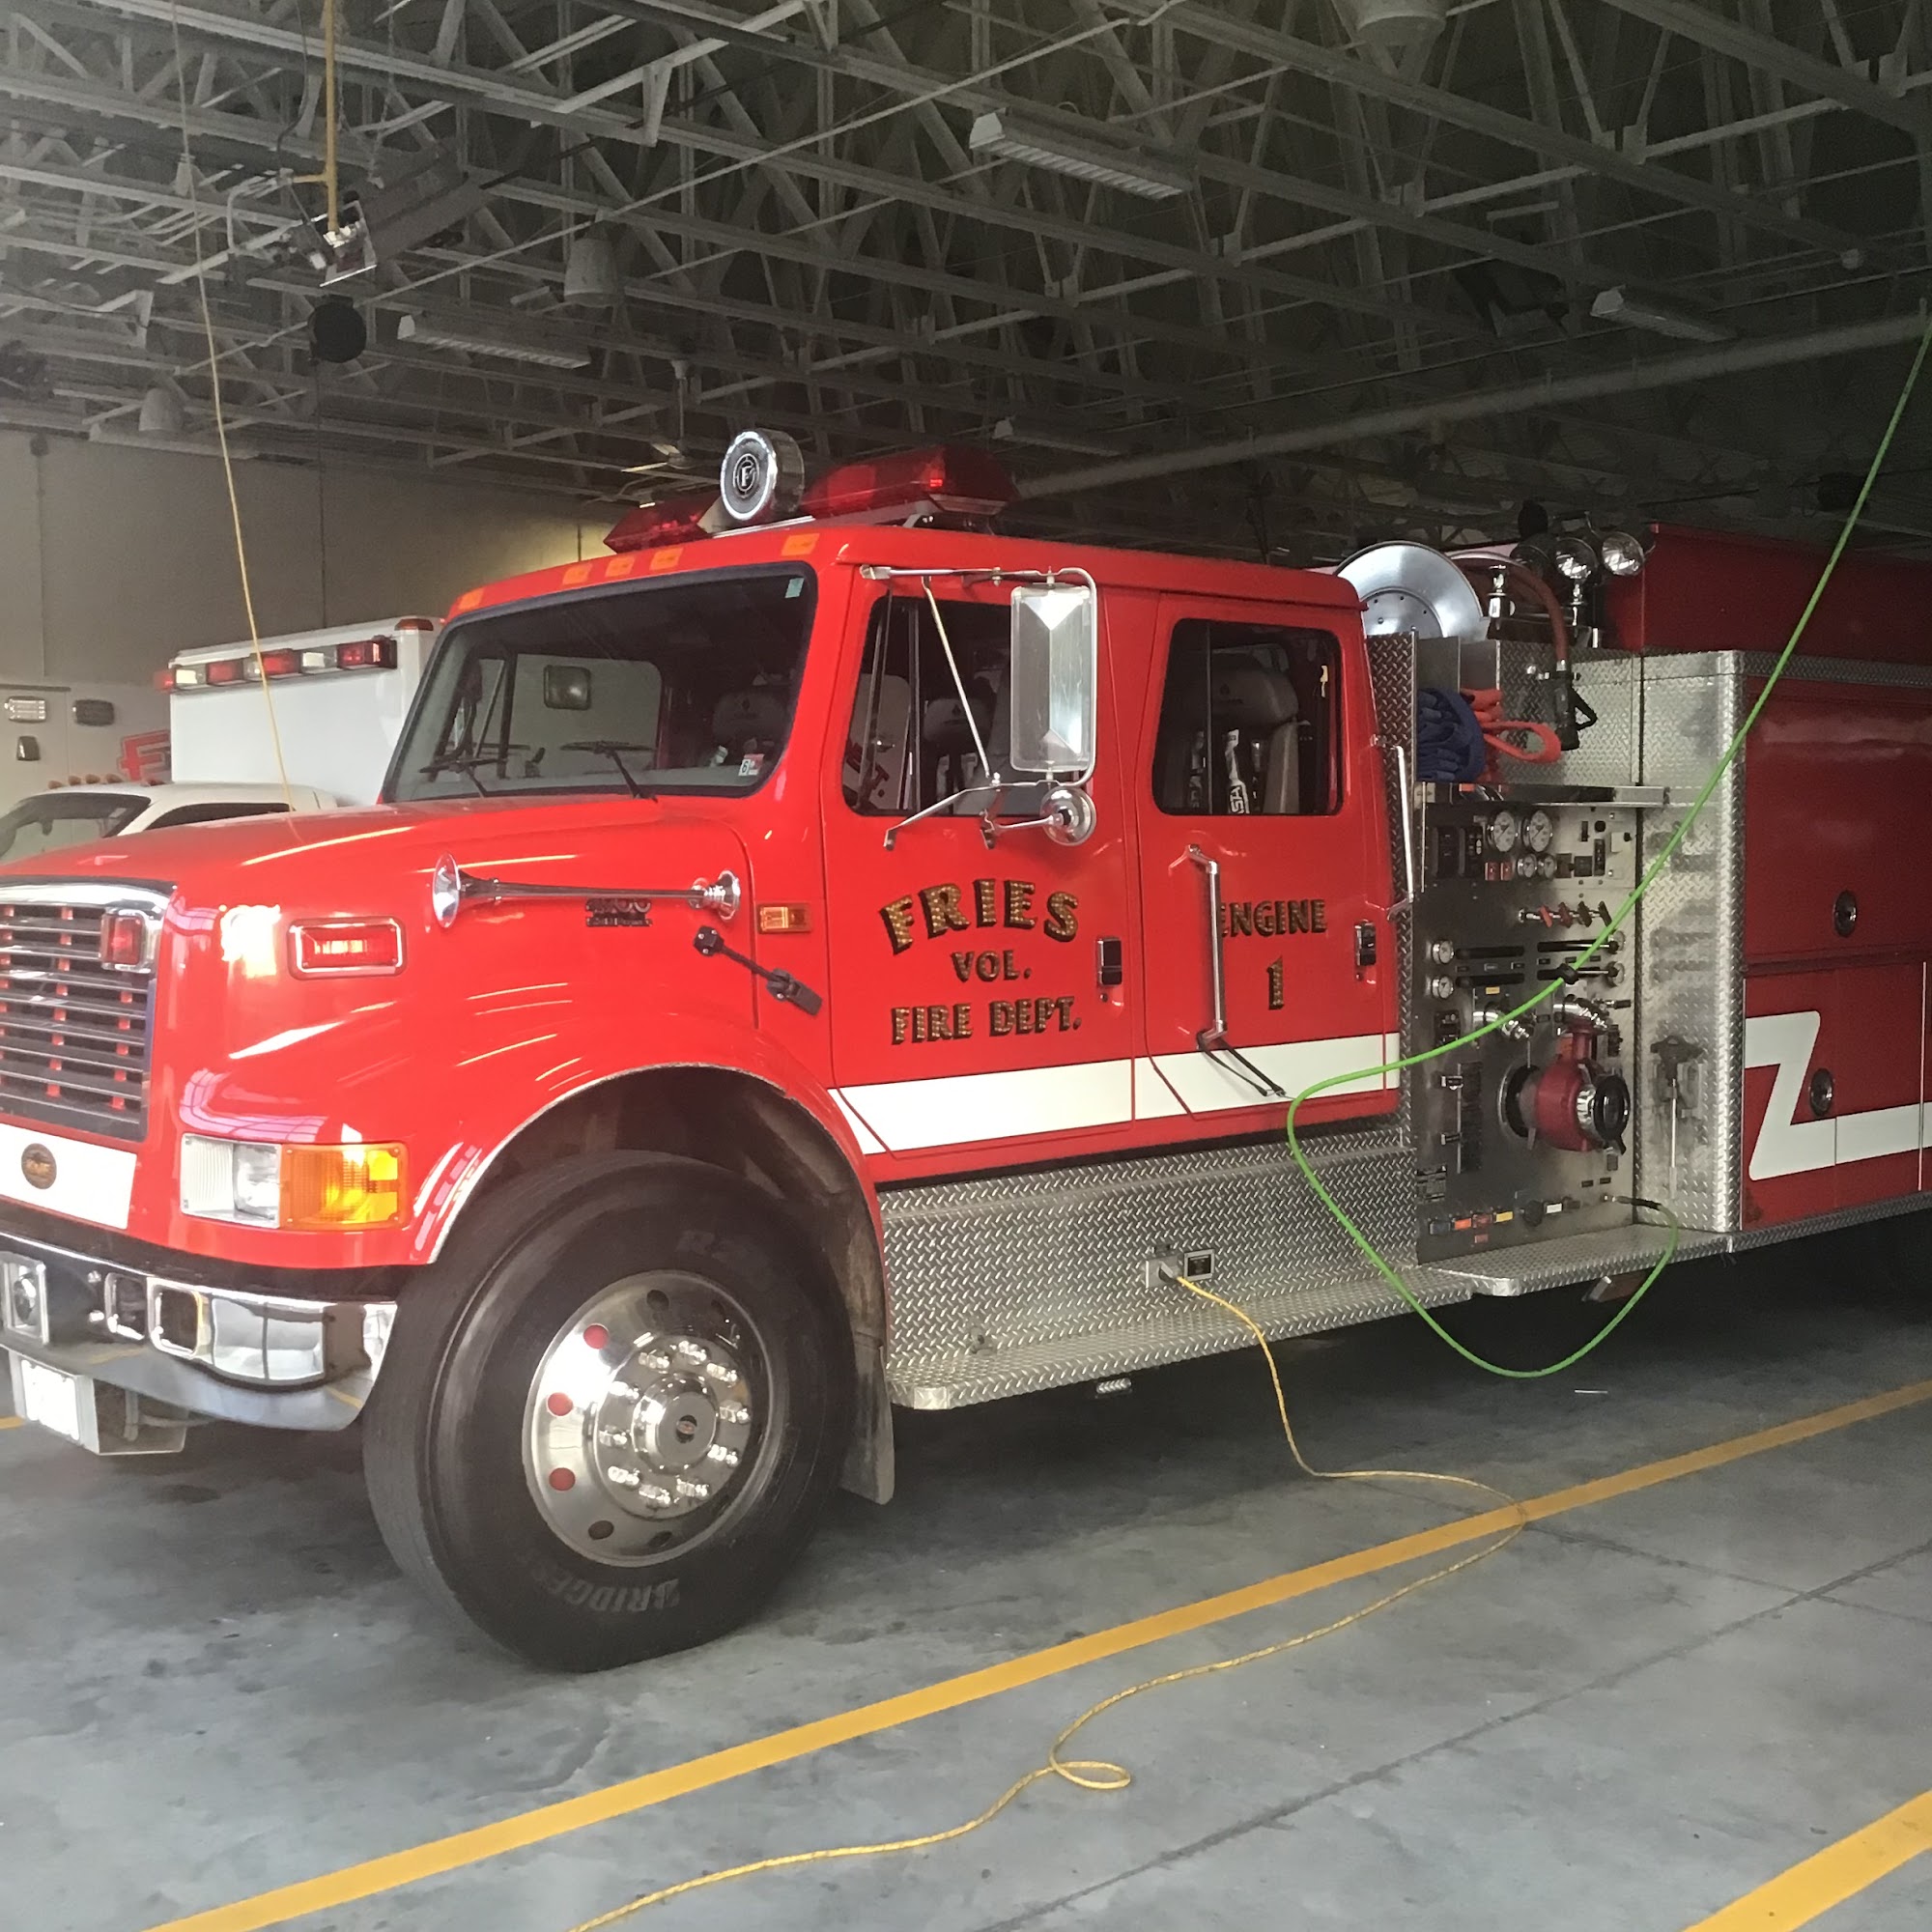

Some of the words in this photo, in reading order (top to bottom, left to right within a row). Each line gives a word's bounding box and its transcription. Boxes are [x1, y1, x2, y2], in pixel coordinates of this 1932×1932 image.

[879, 878, 1078, 955] FRIES
[951, 950, 1032, 983] VOL.
[1266, 955, 1285, 1010] 1
[891, 1003, 973, 1045] FIRE
[989, 996, 1083, 1037] DEPT.
